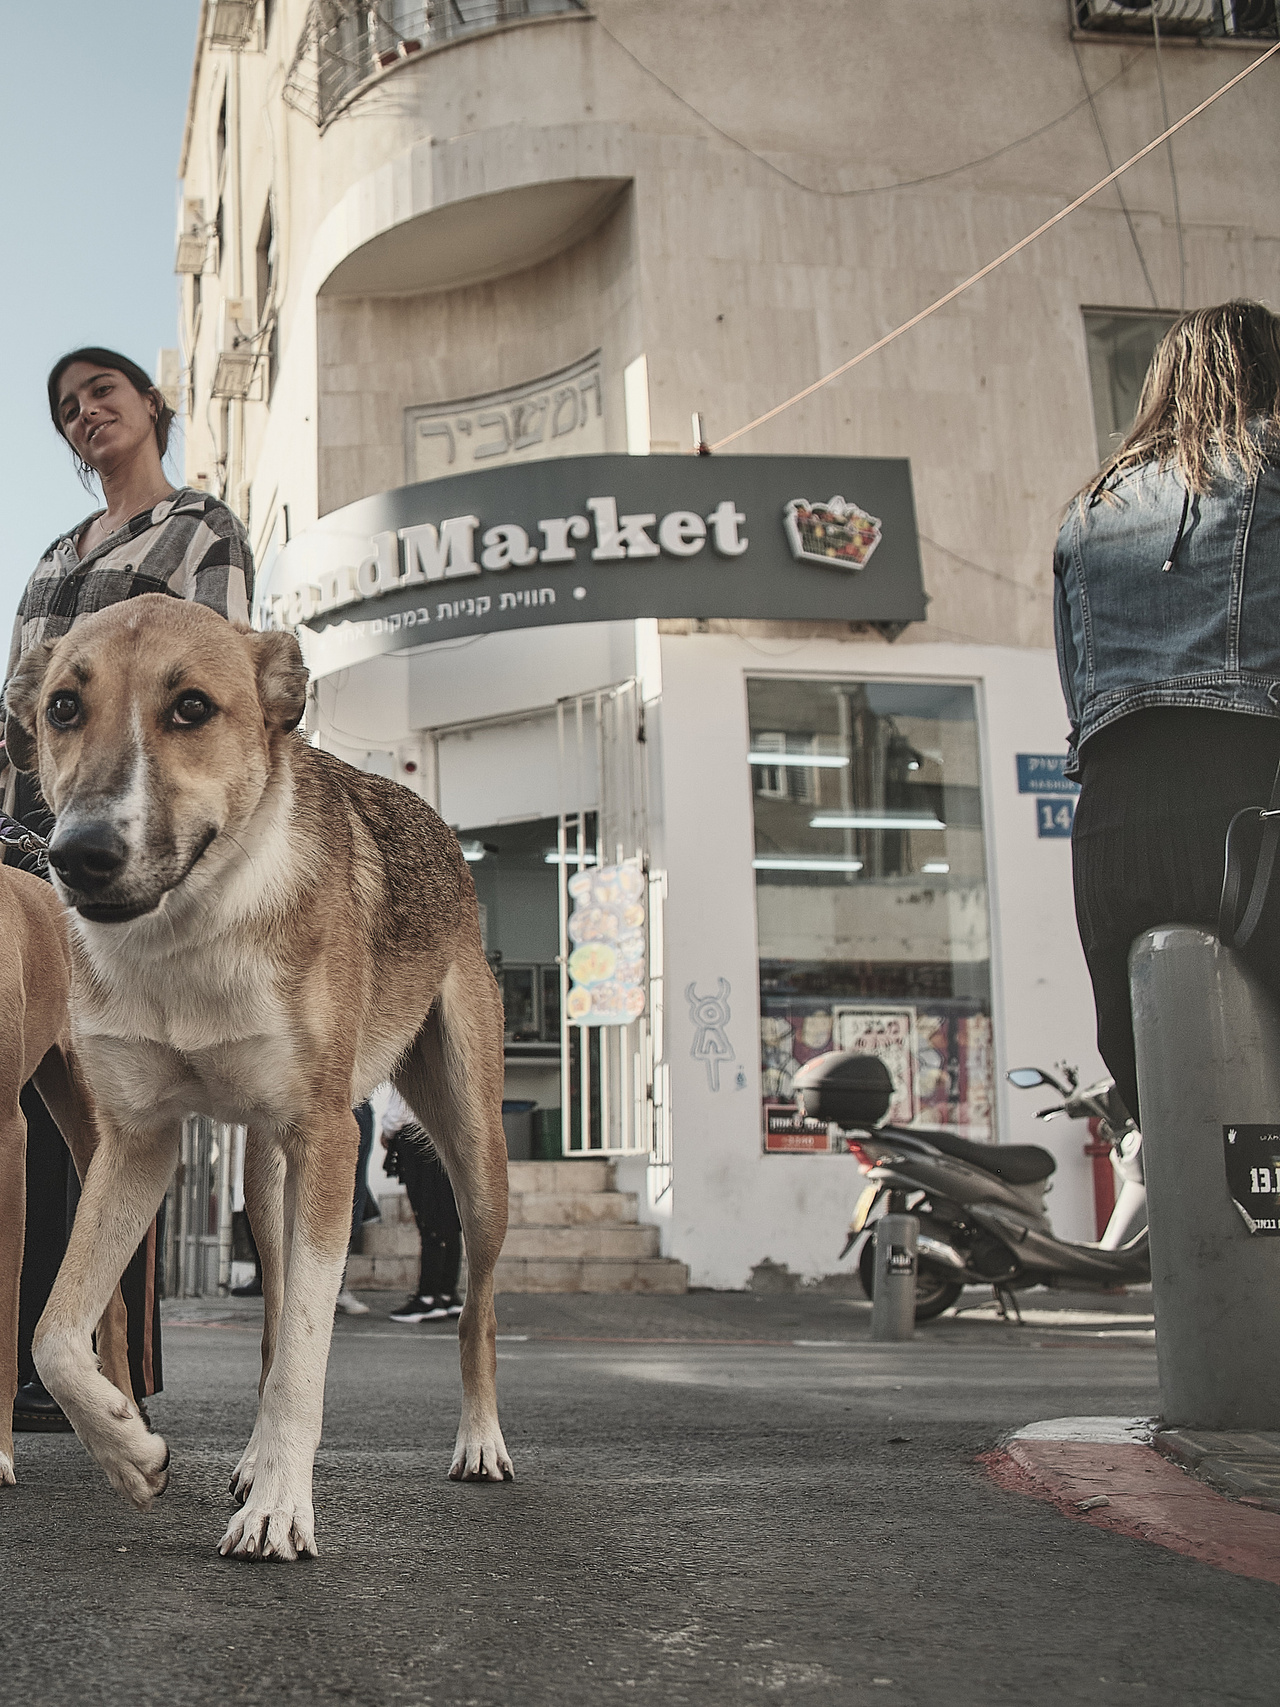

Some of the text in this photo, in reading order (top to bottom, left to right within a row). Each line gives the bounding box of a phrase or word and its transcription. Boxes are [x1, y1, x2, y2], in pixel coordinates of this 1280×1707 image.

[419, 372, 603, 465] המשביר
[436, 595, 492, 622] קניות
[499, 587, 556, 612] חווית
[371, 606, 431, 635] במקום
[1042, 805, 1072, 830] 14
